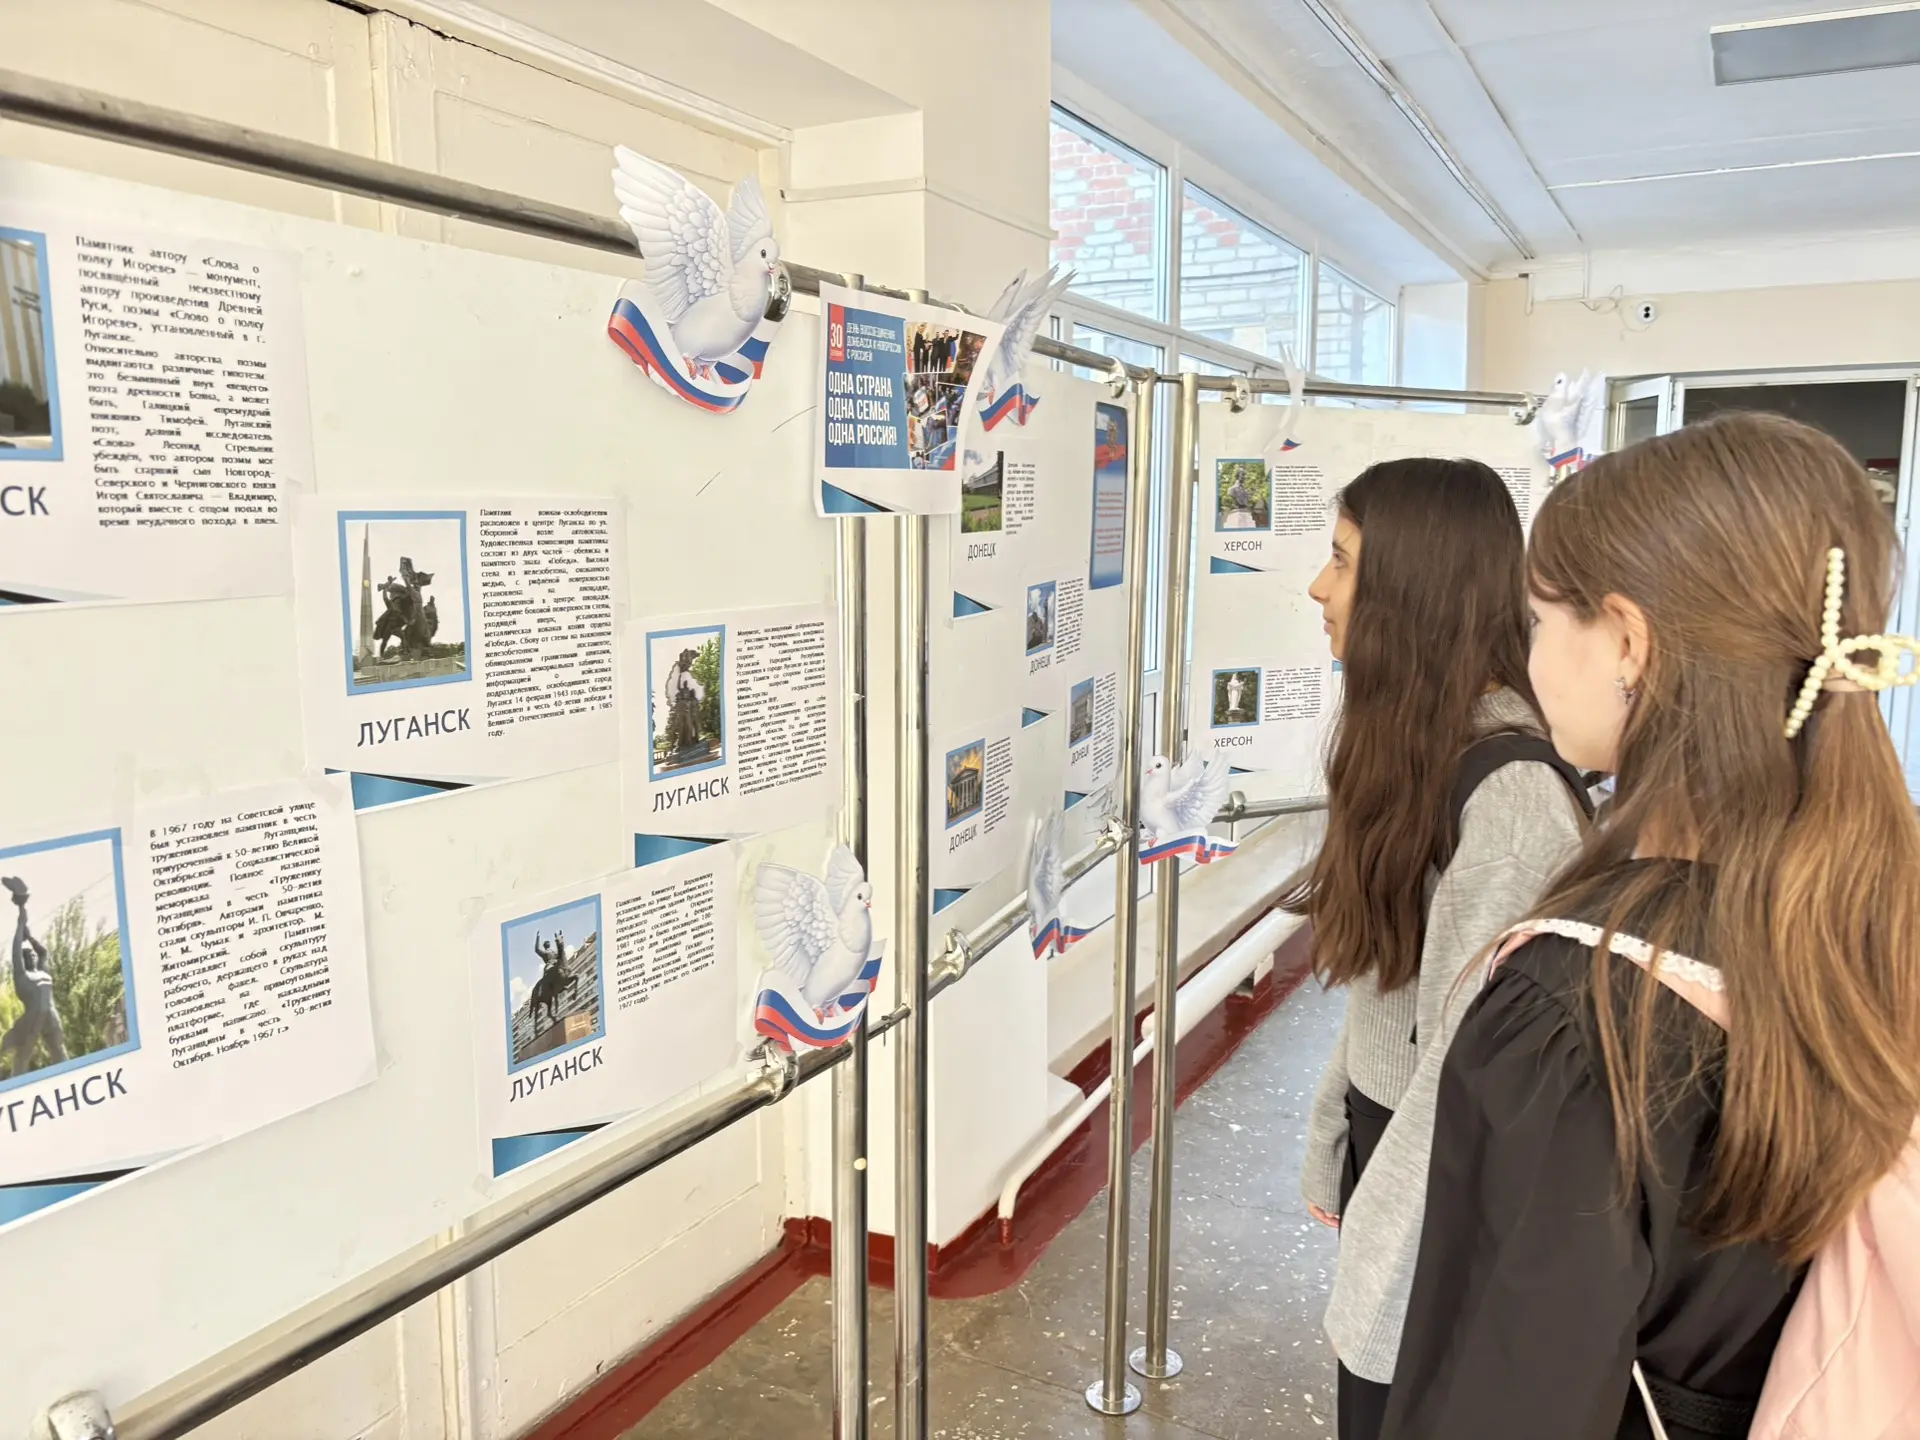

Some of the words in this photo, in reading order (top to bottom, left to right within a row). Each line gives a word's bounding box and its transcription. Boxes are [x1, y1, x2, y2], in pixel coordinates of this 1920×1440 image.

[830, 323, 842, 348] 30
[828, 371, 854, 395] ОДНА
[856, 374, 892, 398] СТРАНА
[828, 397, 855, 420] ОДНА
[857, 400, 890, 421] СЕМЬЯ
[828, 422, 855, 446] ОДНА
[857, 424, 898, 446] РОССИЯ!
[968, 543, 996, 561] ДОНЕЦК
[1224, 541, 1262, 551] ХЕРСОН
[1030, 654, 1051, 676] ДОНЕЦК
[357, 708, 470, 747] ЛУГАНСК
[1214, 736, 1252, 748] ХЕРСОН
[1071, 744, 1089, 766] ДОНЕЦК
[652, 776, 730, 812] ЛУГАНСК
[163, 822, 186, 834] 1967
[949, 824, 977, 854] ДОНЕЦК
[253, 1028, 273, 1041] 1967
[510, 1046, 603, 1102] ЛУГАНСК
[0, 1068, 127, 1132] ГАНСК
